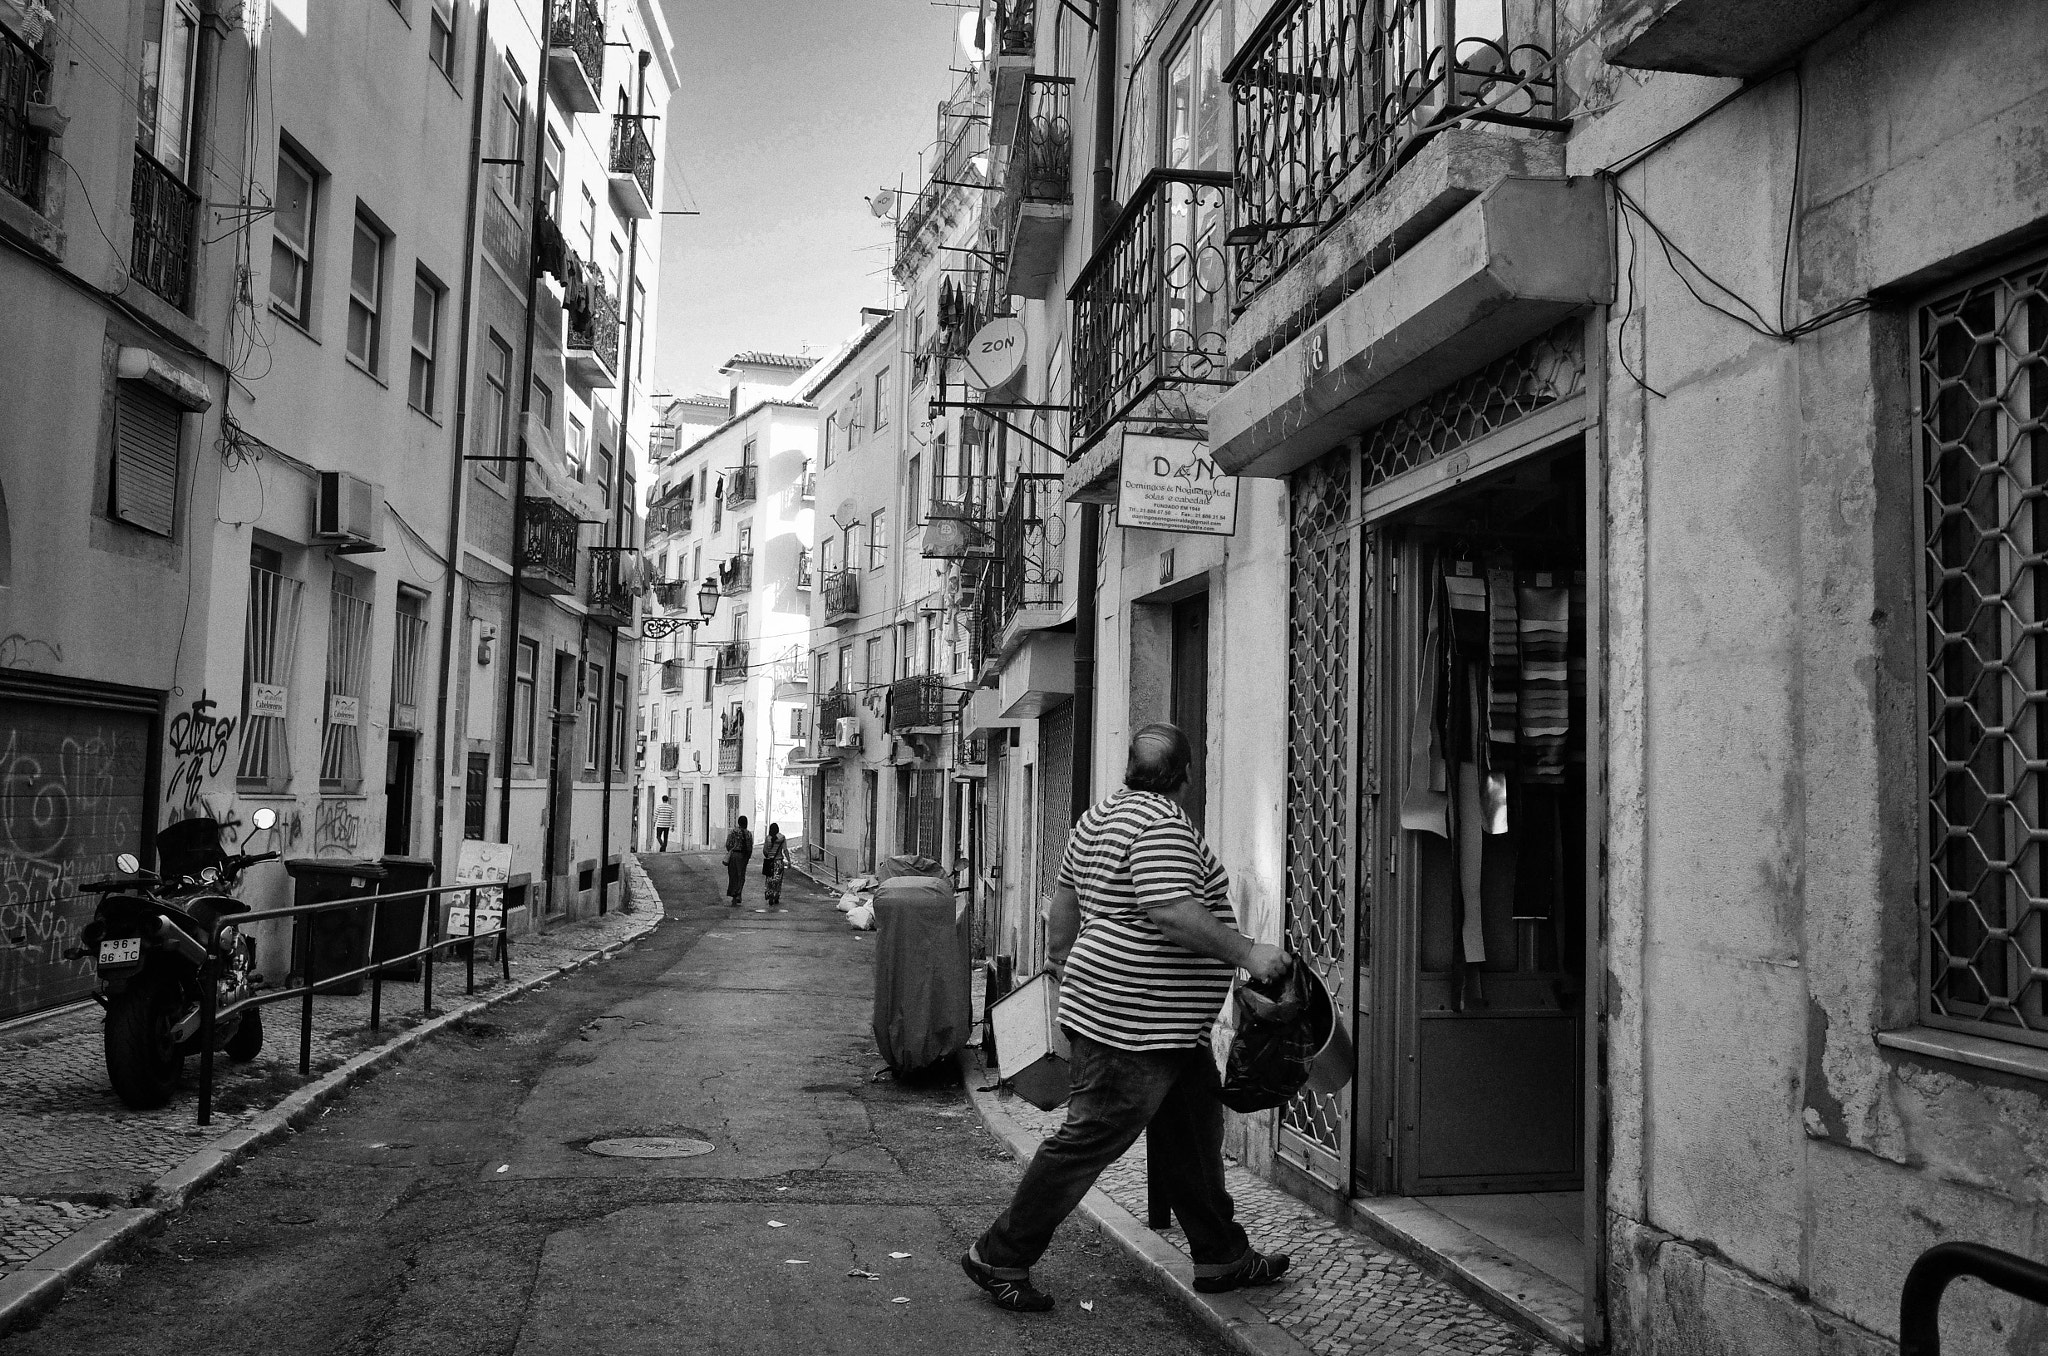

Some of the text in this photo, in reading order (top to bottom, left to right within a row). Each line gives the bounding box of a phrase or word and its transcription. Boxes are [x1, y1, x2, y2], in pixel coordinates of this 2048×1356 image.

[982, 336, 1015, 354] ZON
[1153, 456, 1171, 477] D
[1195, 458, 1215, 481] N
[1125, 480, 1165, 492] Domingos
[1175, 485, 1212, 496] Nogueira
[1144, 492, 1165, 501] solas
[1174, 494, 1211, 505] cabedais
[112, 939, 129, 950] 96
[101, 950, 138, 963] 96 TC
